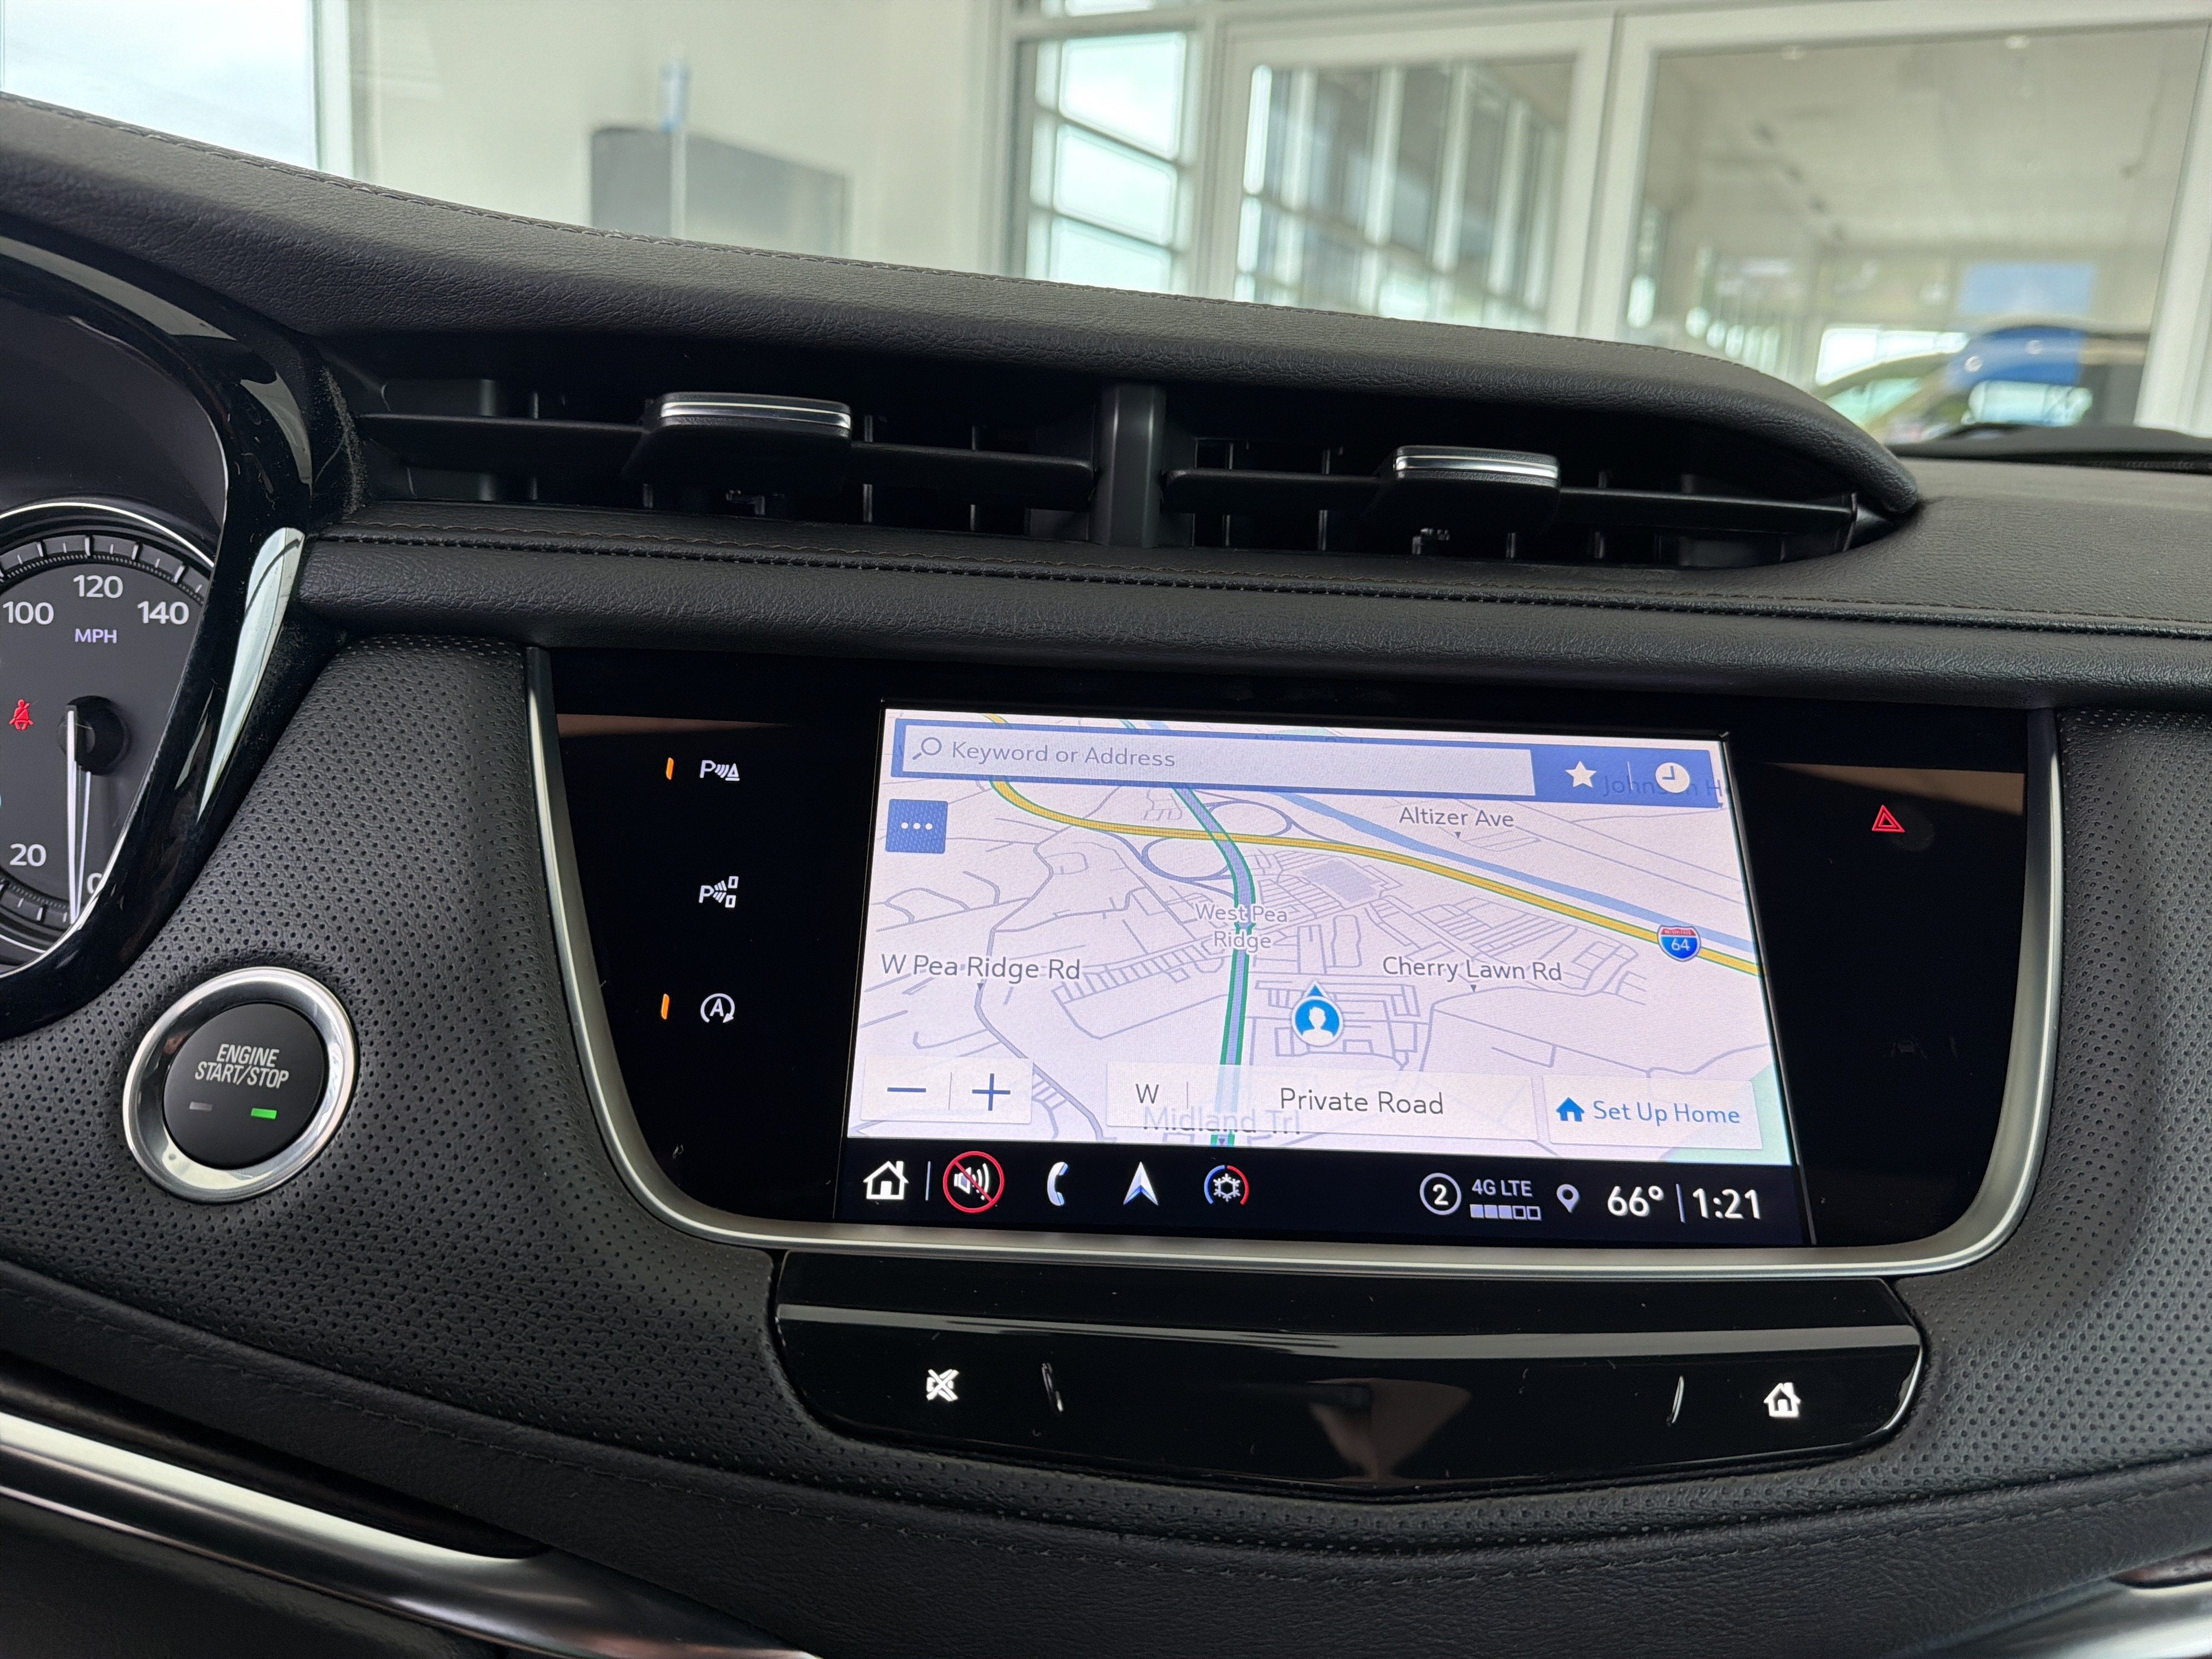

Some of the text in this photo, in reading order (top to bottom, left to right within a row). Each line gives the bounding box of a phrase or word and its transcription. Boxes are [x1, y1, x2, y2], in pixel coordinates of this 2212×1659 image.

[73, 574, 123, 599] 120
[2, 601, 54, 625] 100
[137, 601, 190, 625] 140
[75, 628, 117, 644] MPH
[952, 741, 1176, 767] Keyword or Address
[1399, 806, 1514, 827] Altizer Ave
[9, 843, 47, 867] 20
[1195, 904, 1288, 923] West Pea
[1214, 930, 1271, 953] Ridge
[1671, 938, 1691, 951] 64
[881, 953, 1080, 985] W Pea Ridge Rd
[1383, 956, 1562, 983] Cherry Lawn Rd
[216, 1043, 280, 1068] ENGINE
[194, 1061, 290, 1089] START/STOP
[1135, 1083, 1159, 1104] W
[1280, 1087, 1443, 1115] Private Road
[1143, 1105, 1257, 1133] Midland
[1593, 1100, 1741, 1127] Set Up Home
[1432, 1184, 1449, 1206] 2
[1471, 1178, 1533, 1197] 4G LTE
[1607, 1185, 1664, 1217] 66°
[1692, 1188, 1761, 1220] 1:21
